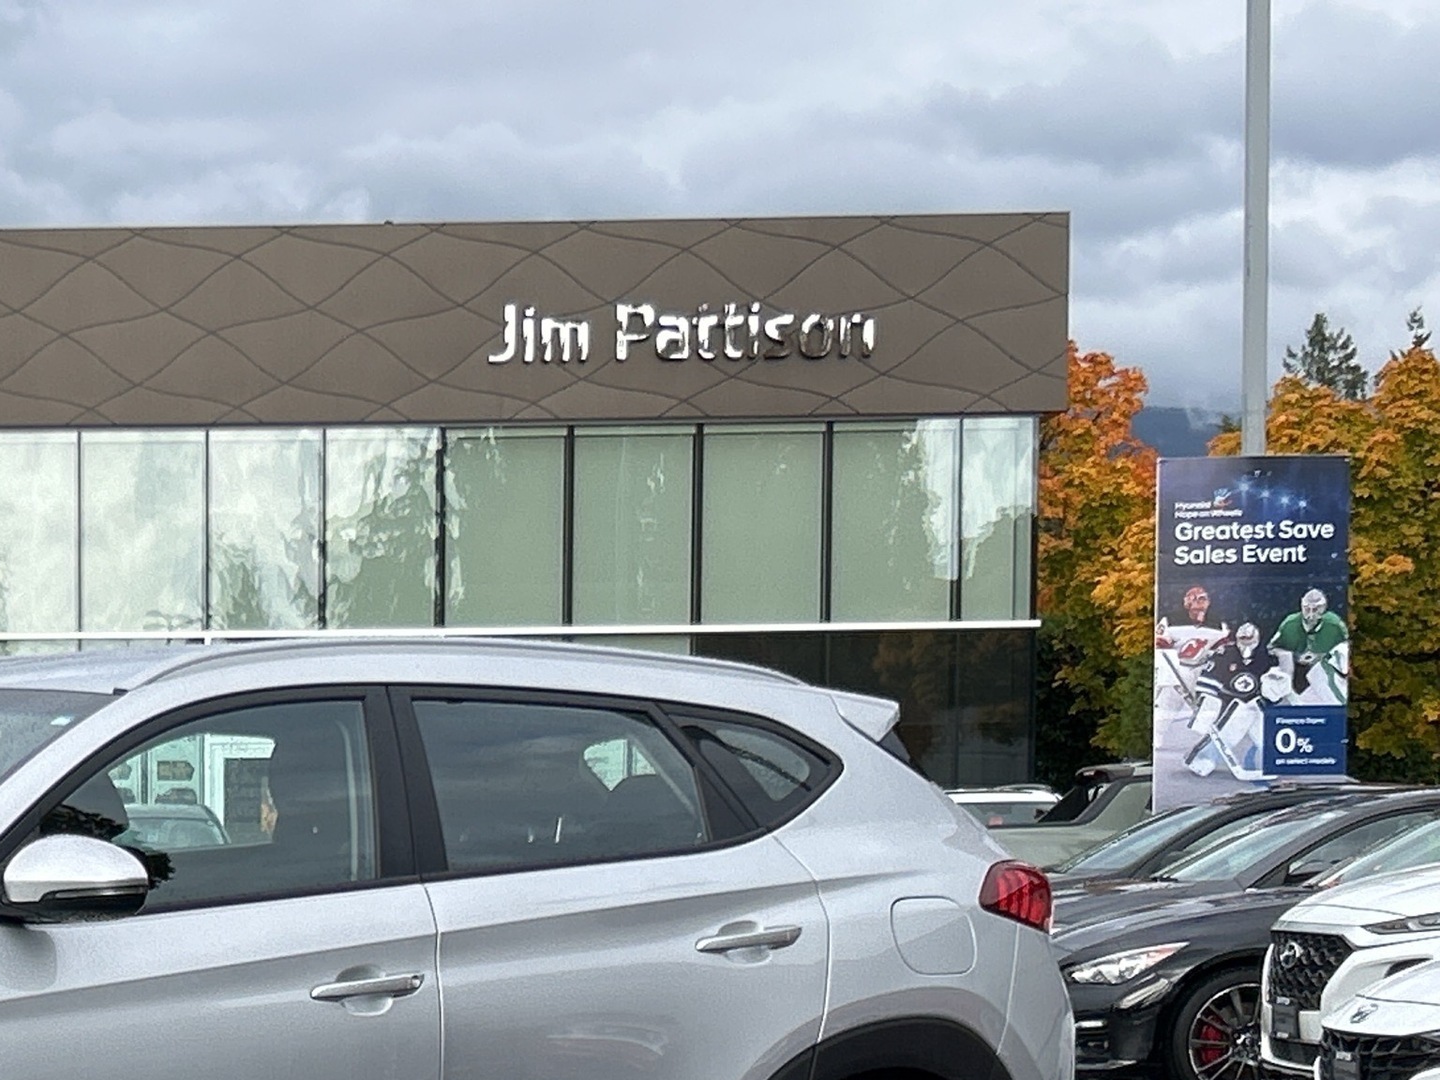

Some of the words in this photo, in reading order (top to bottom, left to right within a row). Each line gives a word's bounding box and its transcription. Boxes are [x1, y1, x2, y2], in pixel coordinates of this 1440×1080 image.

[487, 302, 590, 364] Jim
[614, 301, 878, 362] Pattison
[1174, 519, 1276, 542] Greatest
[1278, 519, 1335, 540] Save
[1173, 545, 1238, 565] Sales
[1242, 544, 1308, 565] Event
[1275, 728, 1314, 754] 0%
